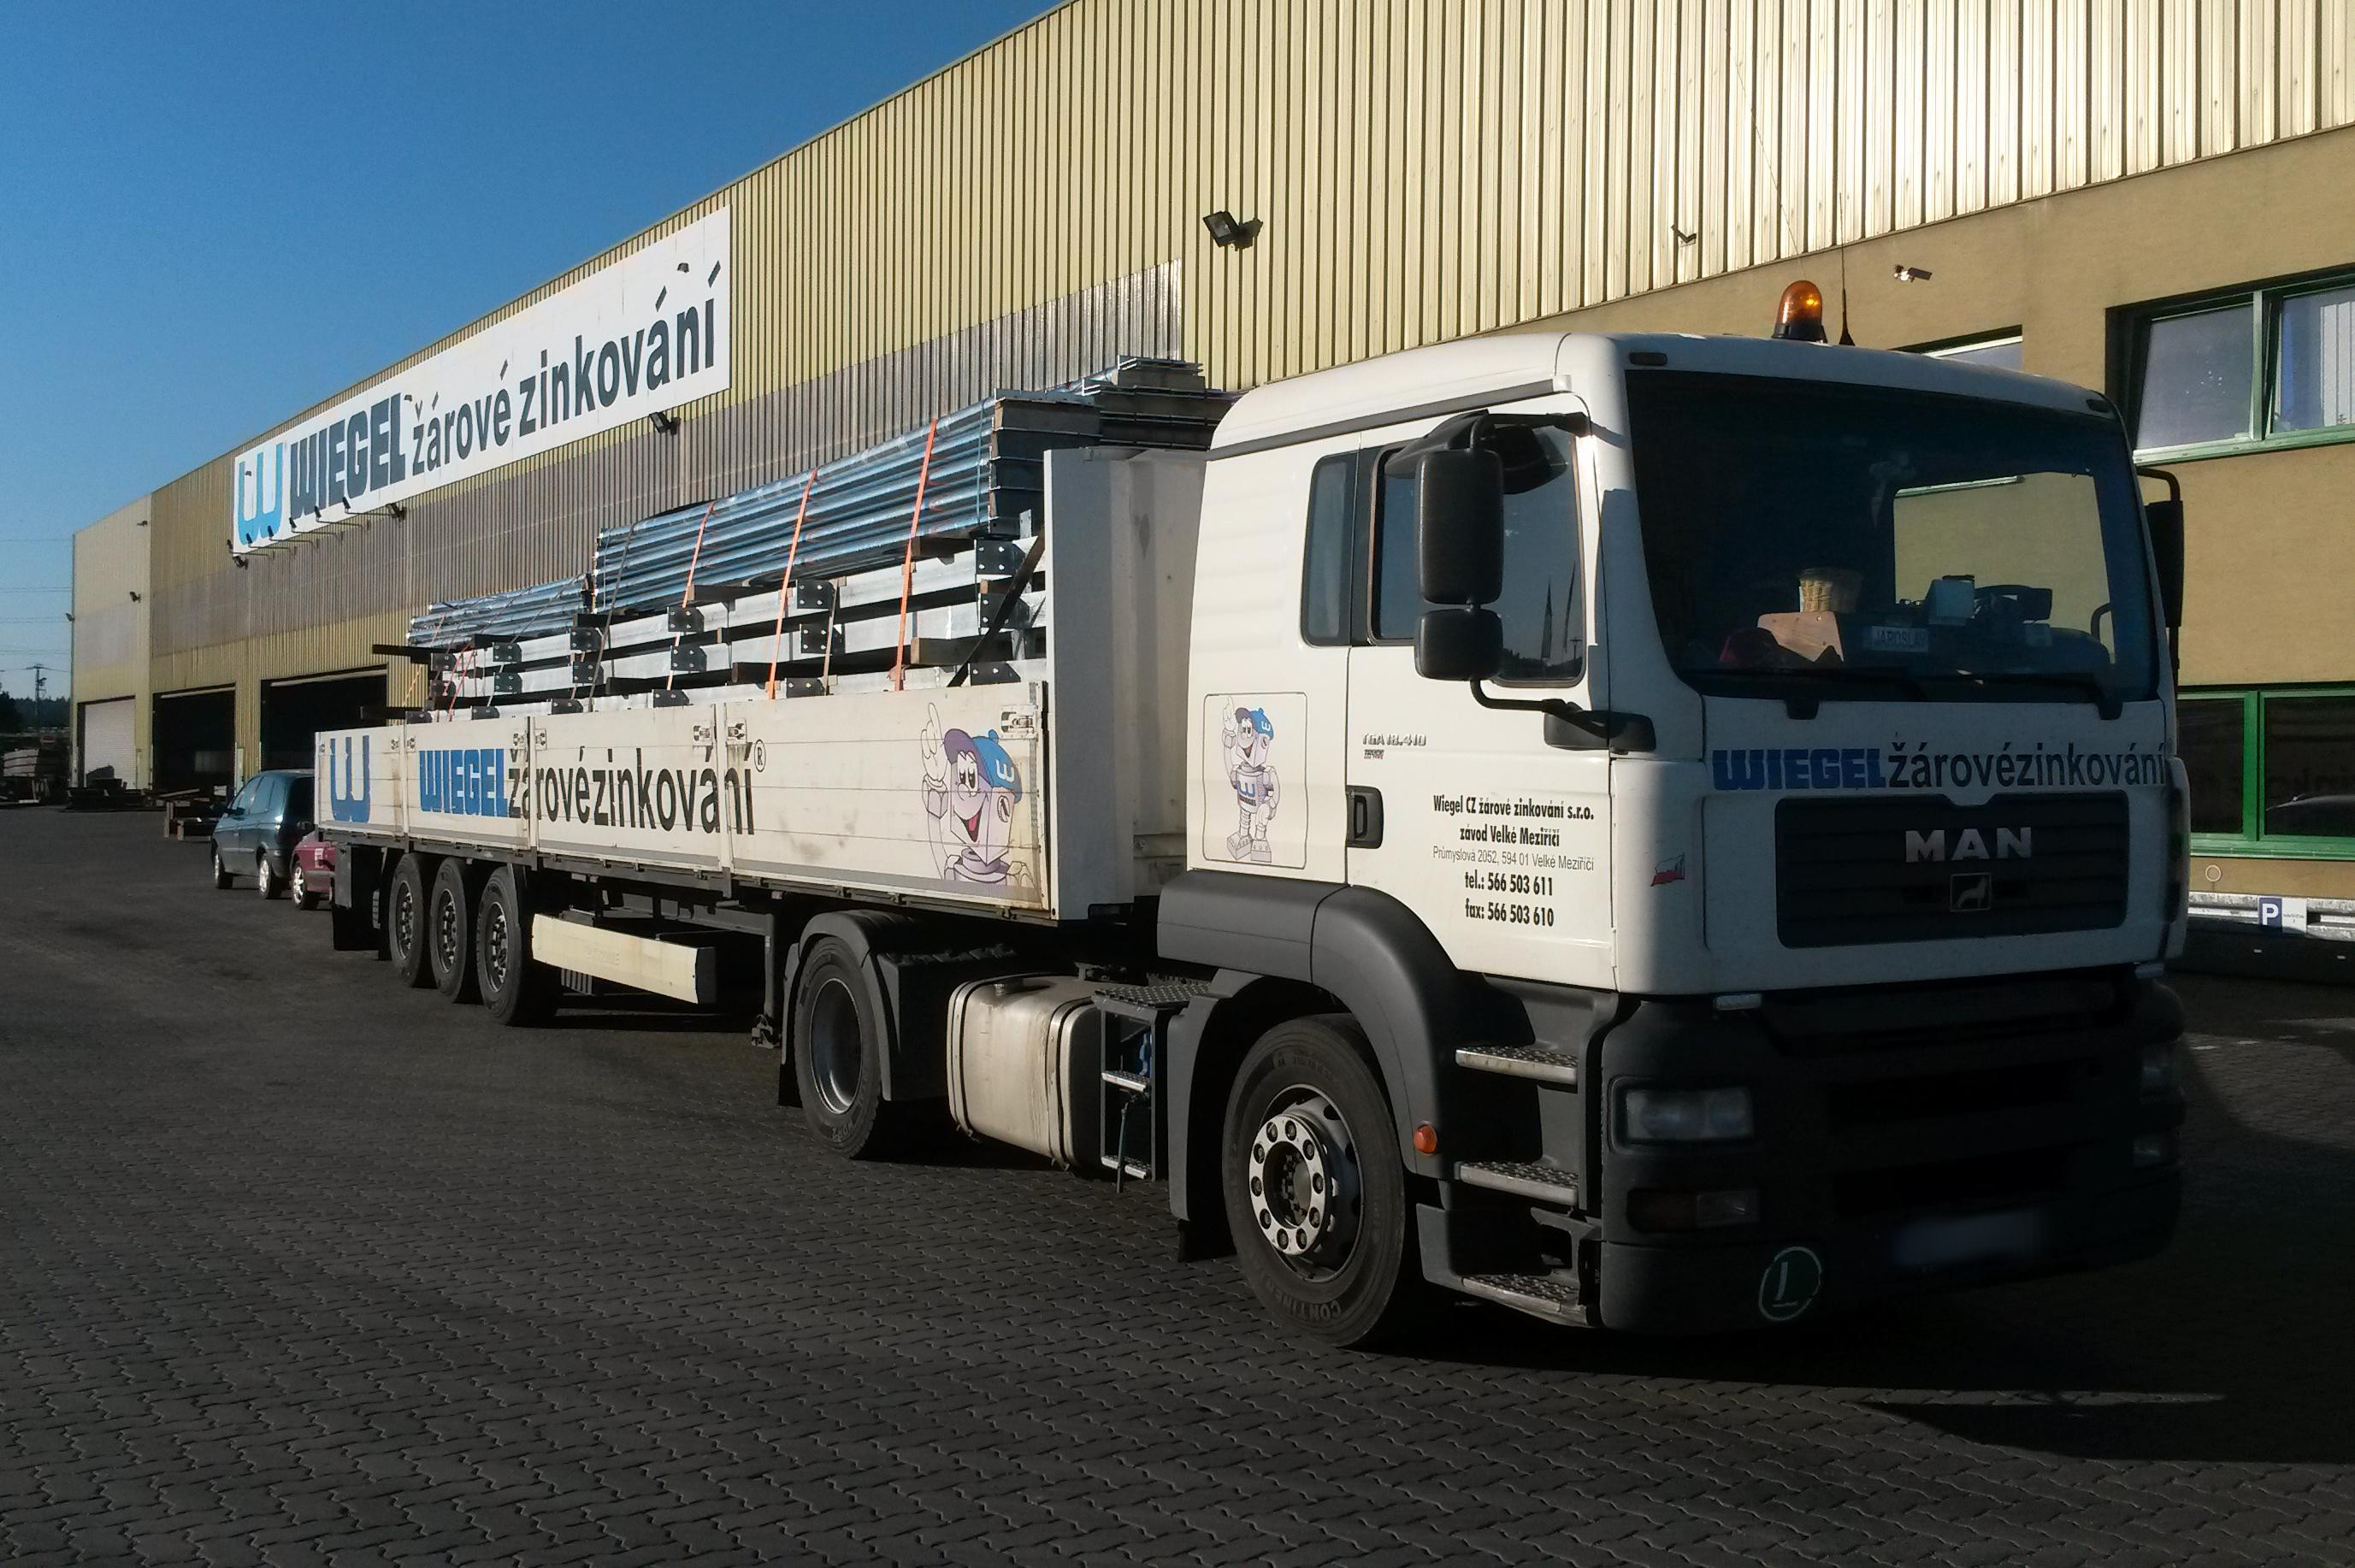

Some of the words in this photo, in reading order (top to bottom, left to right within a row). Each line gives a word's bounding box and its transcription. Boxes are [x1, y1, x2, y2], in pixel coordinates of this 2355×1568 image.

[290, 392, 406, 520] WIEGEL
[412, 359, 512, 476] žárové
[519, 260, 722, 438] zinkování
[419, 748, 509, 818] WIEGEL
[1712, 748, 1886, 791] WIEGEL
[1433, 794, 1463, 816] Wiegel
[1466, 797, 1477, 814] CZ
[1479, 797, 1511, 816] žárové
[1514, 798, 1564, 818] zinkování
[1567, 805, 1594, 820] s.r.o.
[1460, 823, 1488, 842] závod
[1490, 824, 1517, 844] Velké
[1905, 827, 2032, 863] MAN
[1433, 846, 1476, 864] Průmyslová
[1478, 849, 1500, 866] 2052,
[1502, 851, 1517, 865] 594
[1519, 852, 1529, 866] 01
[1532, 853, 1555, 869] Velké
[1465, 869, 1484, 890] tel.:
[1487, 872, 1507, 892] 566
[1509, 874, 1530, 894] 503
[1532, 875, 1553, 896] 611
[1465, 898, 1484, 919] fax:
[1487, 901, 1507, 922] 566
[1509, 904, 1530, 924] 503
[1532, 906, 1555, 927] 610
[2262, 903, 2279, 926] P
